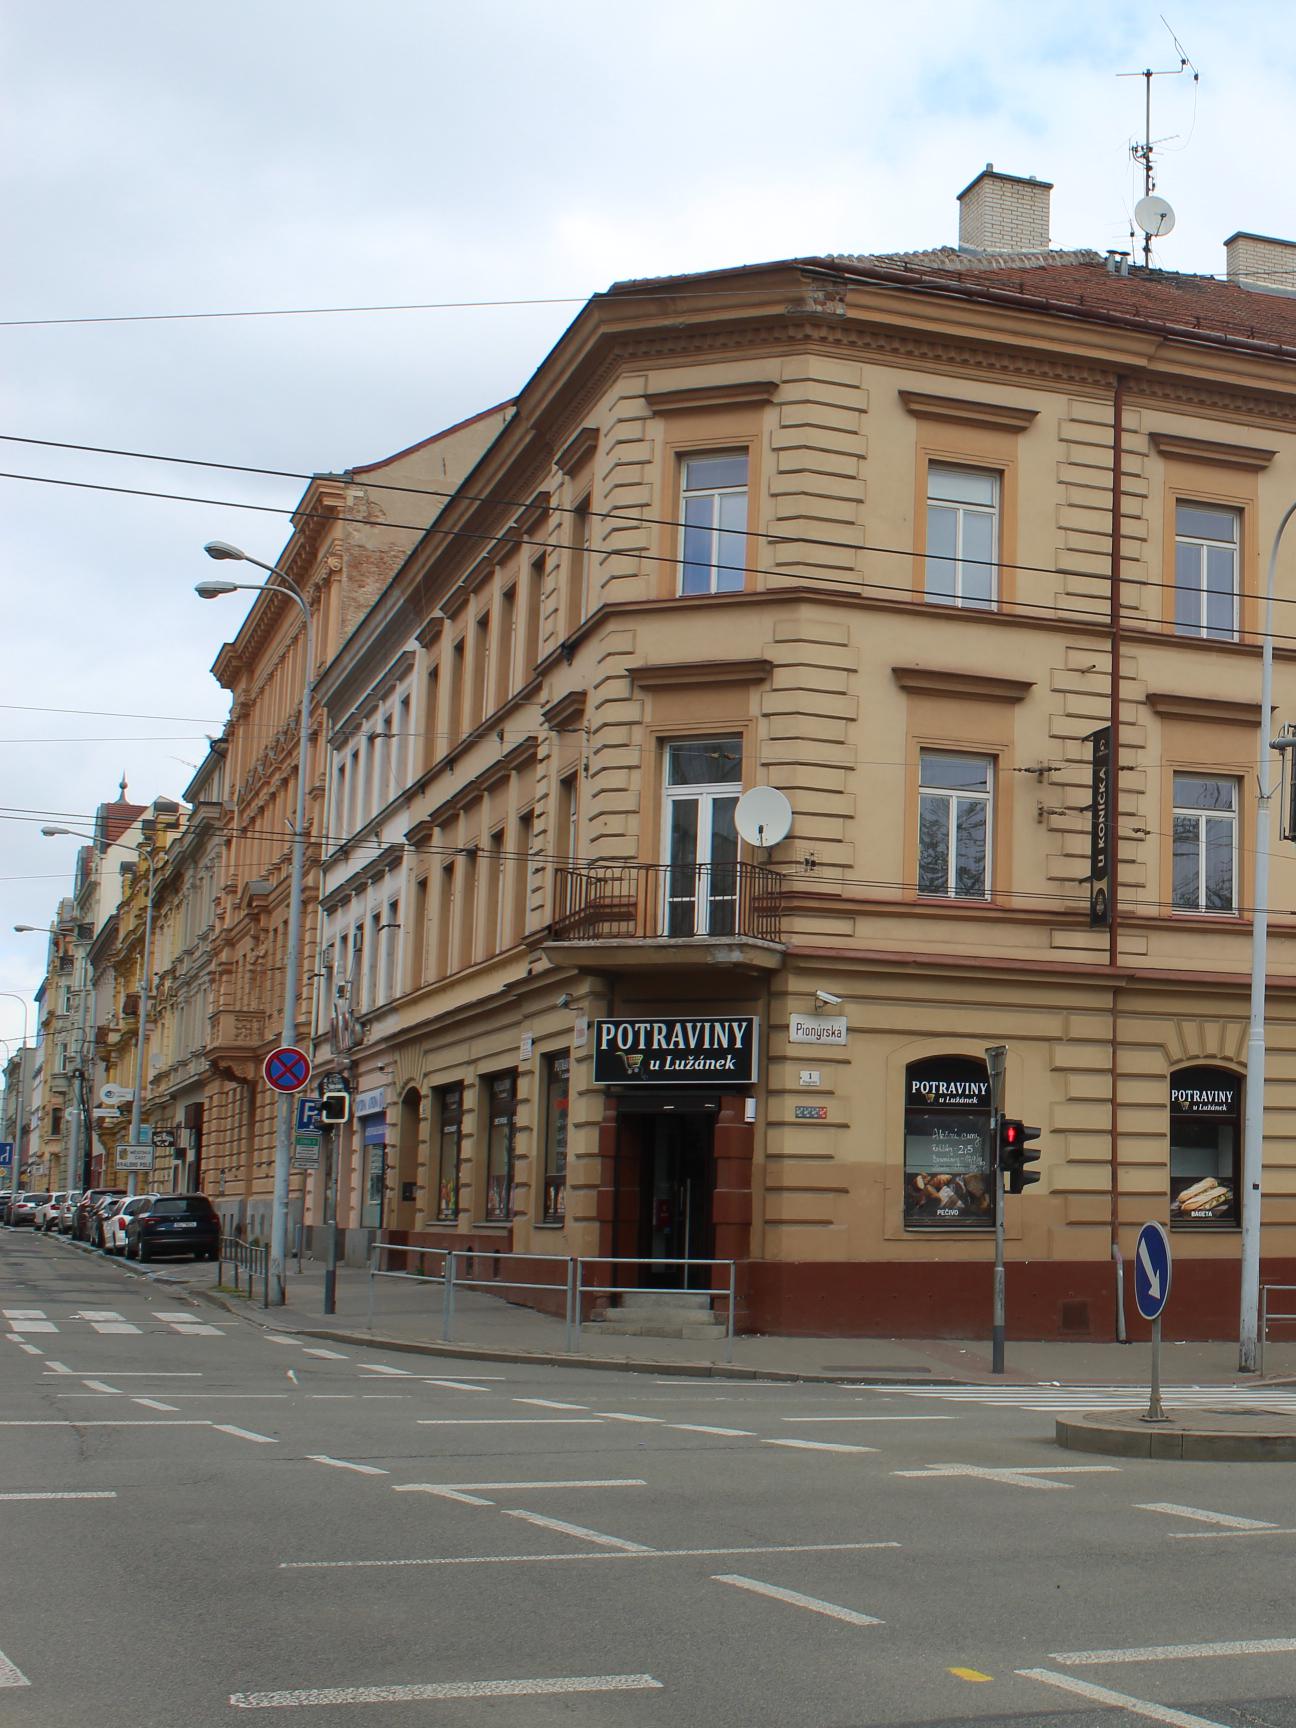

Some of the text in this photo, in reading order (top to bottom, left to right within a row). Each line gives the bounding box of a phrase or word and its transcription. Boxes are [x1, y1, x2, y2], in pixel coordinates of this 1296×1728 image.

[1097, 854, 1105, 867] U
[600, 1022, 748, 1050] POTRAVINY
[796, 1023, 842, 1040] Pionýrská
[650, 1054, 736, 1070] u Lužánek
[808, 1072, 812, 1080] 1
[912, 1081, 988, 1095] POTRAVINY
[946, 1095, 979, 1104] Lužánek
[1171, 1090, 1233, 1103] POTRAVINY
[1199, 1103, 1228, 1111] Lužánek
[937, 1207, 959, 1216] PEČIVO
